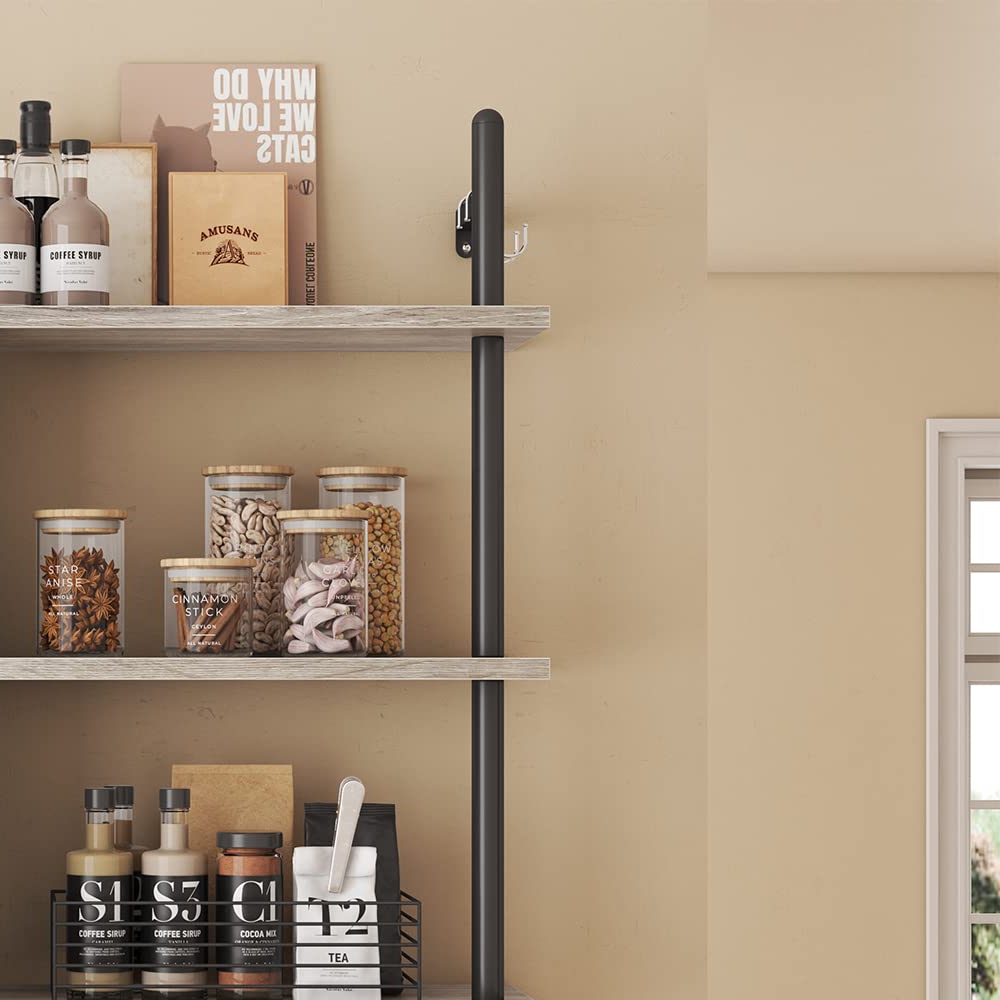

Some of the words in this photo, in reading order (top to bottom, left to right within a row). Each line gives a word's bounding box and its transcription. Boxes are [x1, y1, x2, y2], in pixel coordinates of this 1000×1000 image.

[200, 225, 259, 242] AMUSANS
[3, 250, 27, 260] SYRUP
[50, 250, 76, 260] COFFEE
[78, 250, 102, 260] SYRUP
[48, 565, 79, 575] STAR
[45, 578, 82, 587] ANISE
[172, 594, 238, 604] CINNAMON
[185, 607, 223, 617] STICK
[79, 880, 125, 923] S1
[152, 880, 202, 923] S3
[232, 880, 279, 923] C1
[308, 897, 369, 936] T2
[79, 929, 105, 938] COFFEE
[107, 929, 126, 938] SIRUP
[154, 929, 180, 938] COFFEE
[183, 929, 202, 938] SIRUP
[240, 930, 264, 938] COCOA
[266, 930, 277, 938] MIX
[328, 953, 349, 963] TEA
